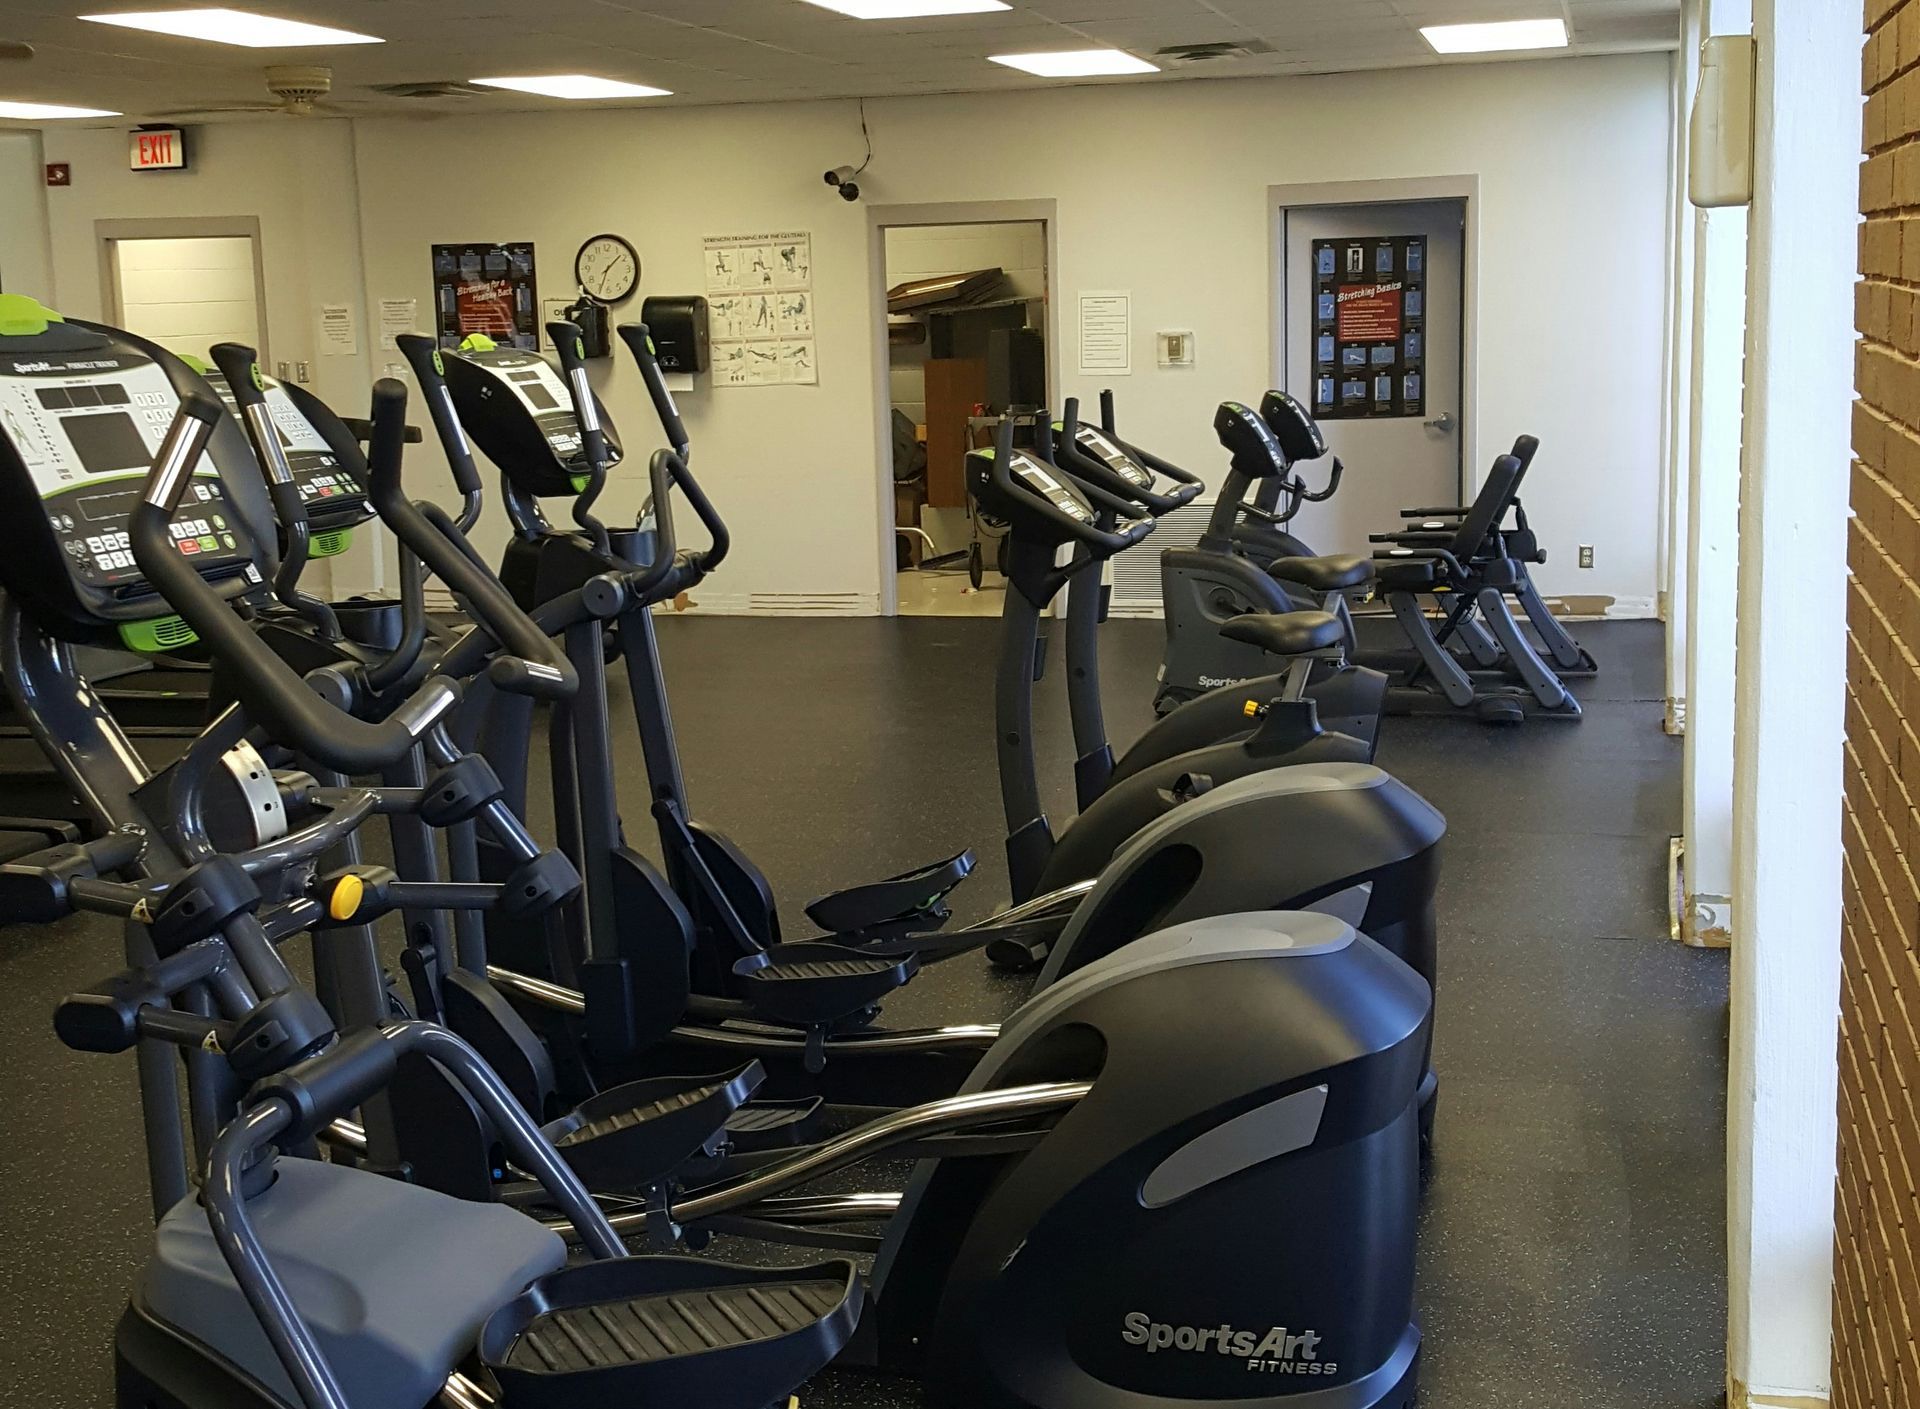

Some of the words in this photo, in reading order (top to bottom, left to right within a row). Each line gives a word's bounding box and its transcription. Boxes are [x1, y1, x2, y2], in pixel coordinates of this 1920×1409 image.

[138, 134, 172, 165] EXIT
[1337, 287, 1376, 303] Stretching
[1376, 281, 1402, 294] Basics
[1121, 1311, 1322, 1361] SportsArt
[1247, 1359, 1338, 1376] FITNESS
